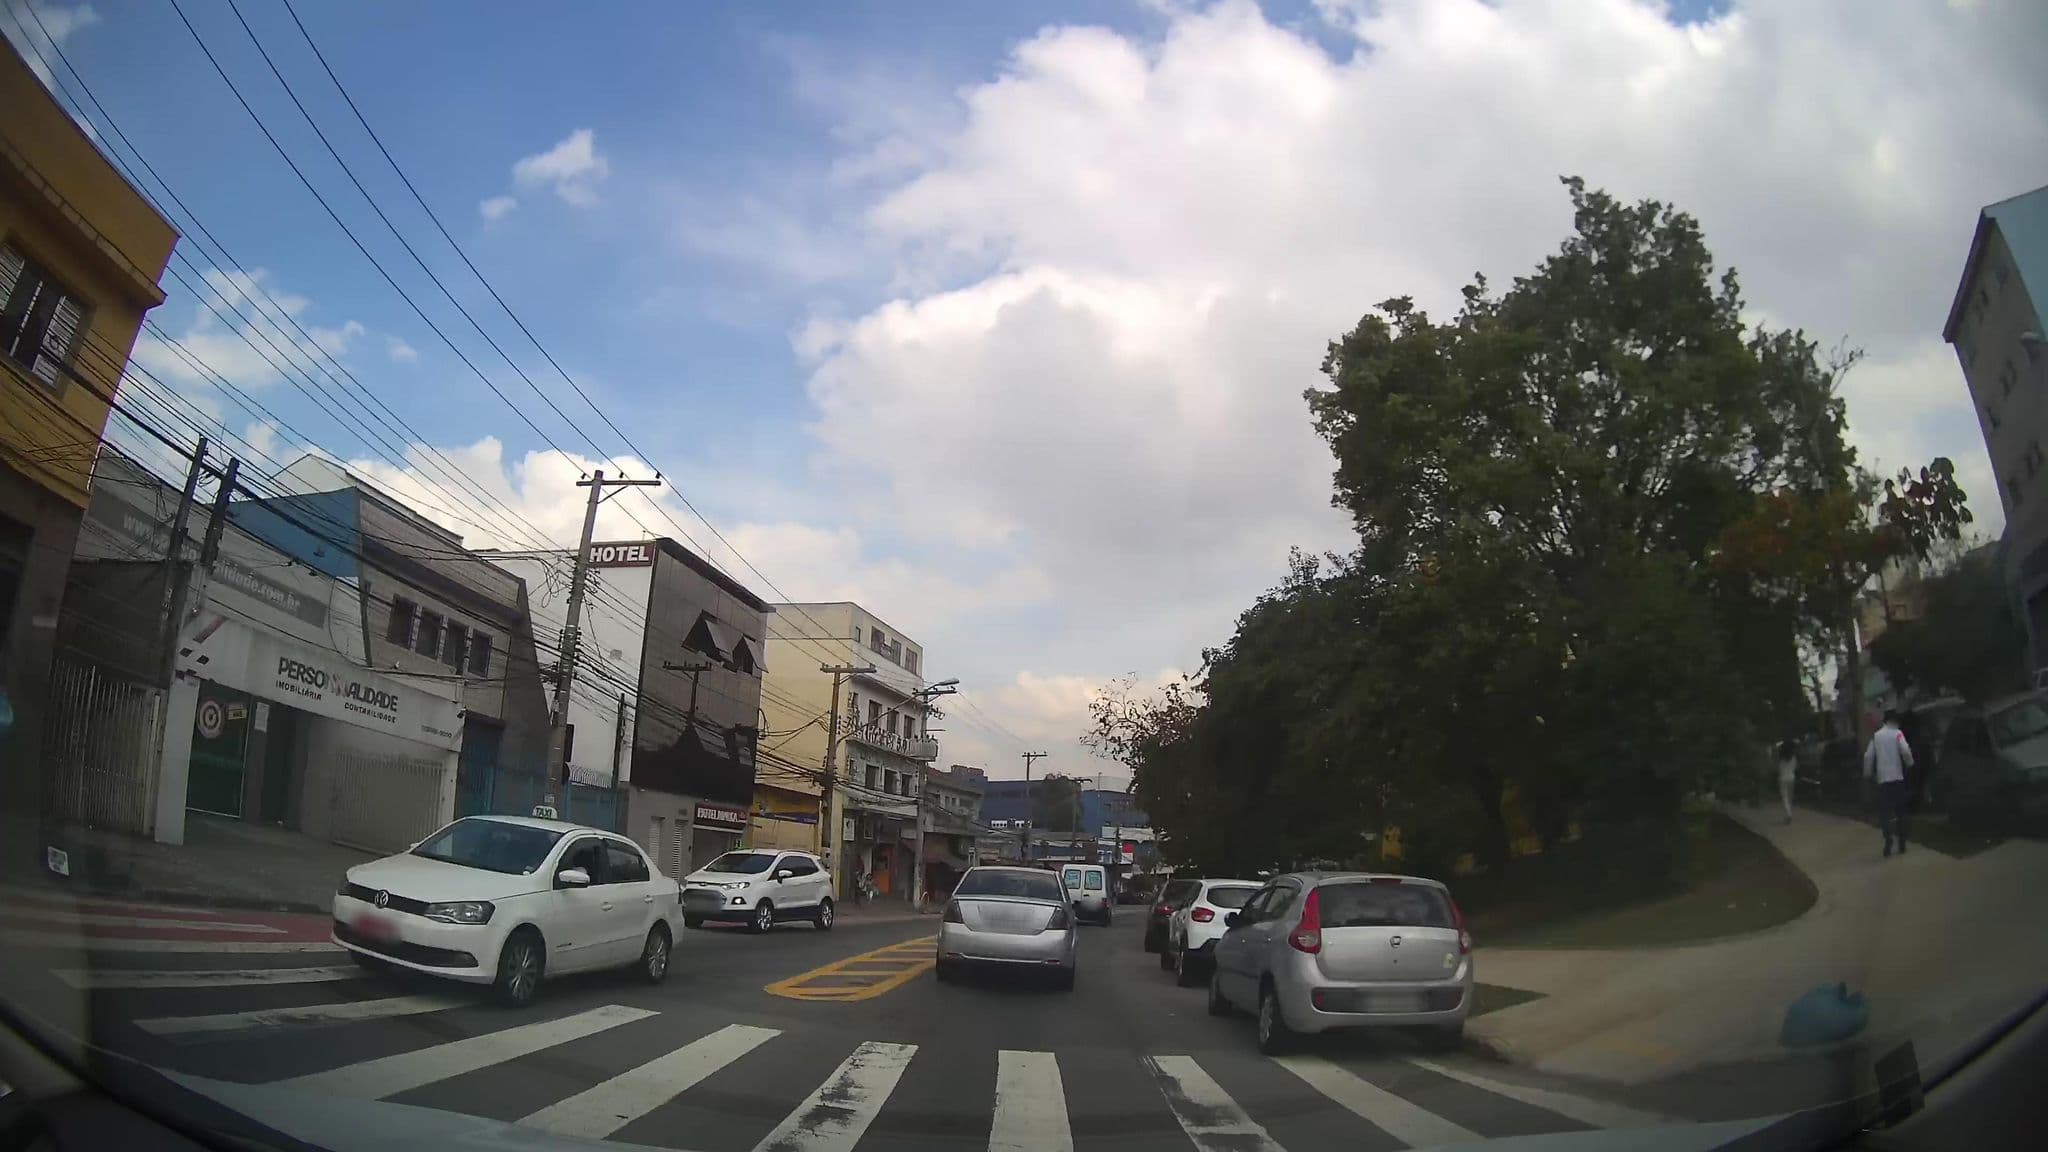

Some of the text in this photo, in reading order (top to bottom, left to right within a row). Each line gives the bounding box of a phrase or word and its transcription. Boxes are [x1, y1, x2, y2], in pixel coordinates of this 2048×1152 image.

[589, 546, 649, 563] HOTEL
[344, 702, 397, 723] CONTABILIDADE
[535, 807, 552, 817] TAXI
